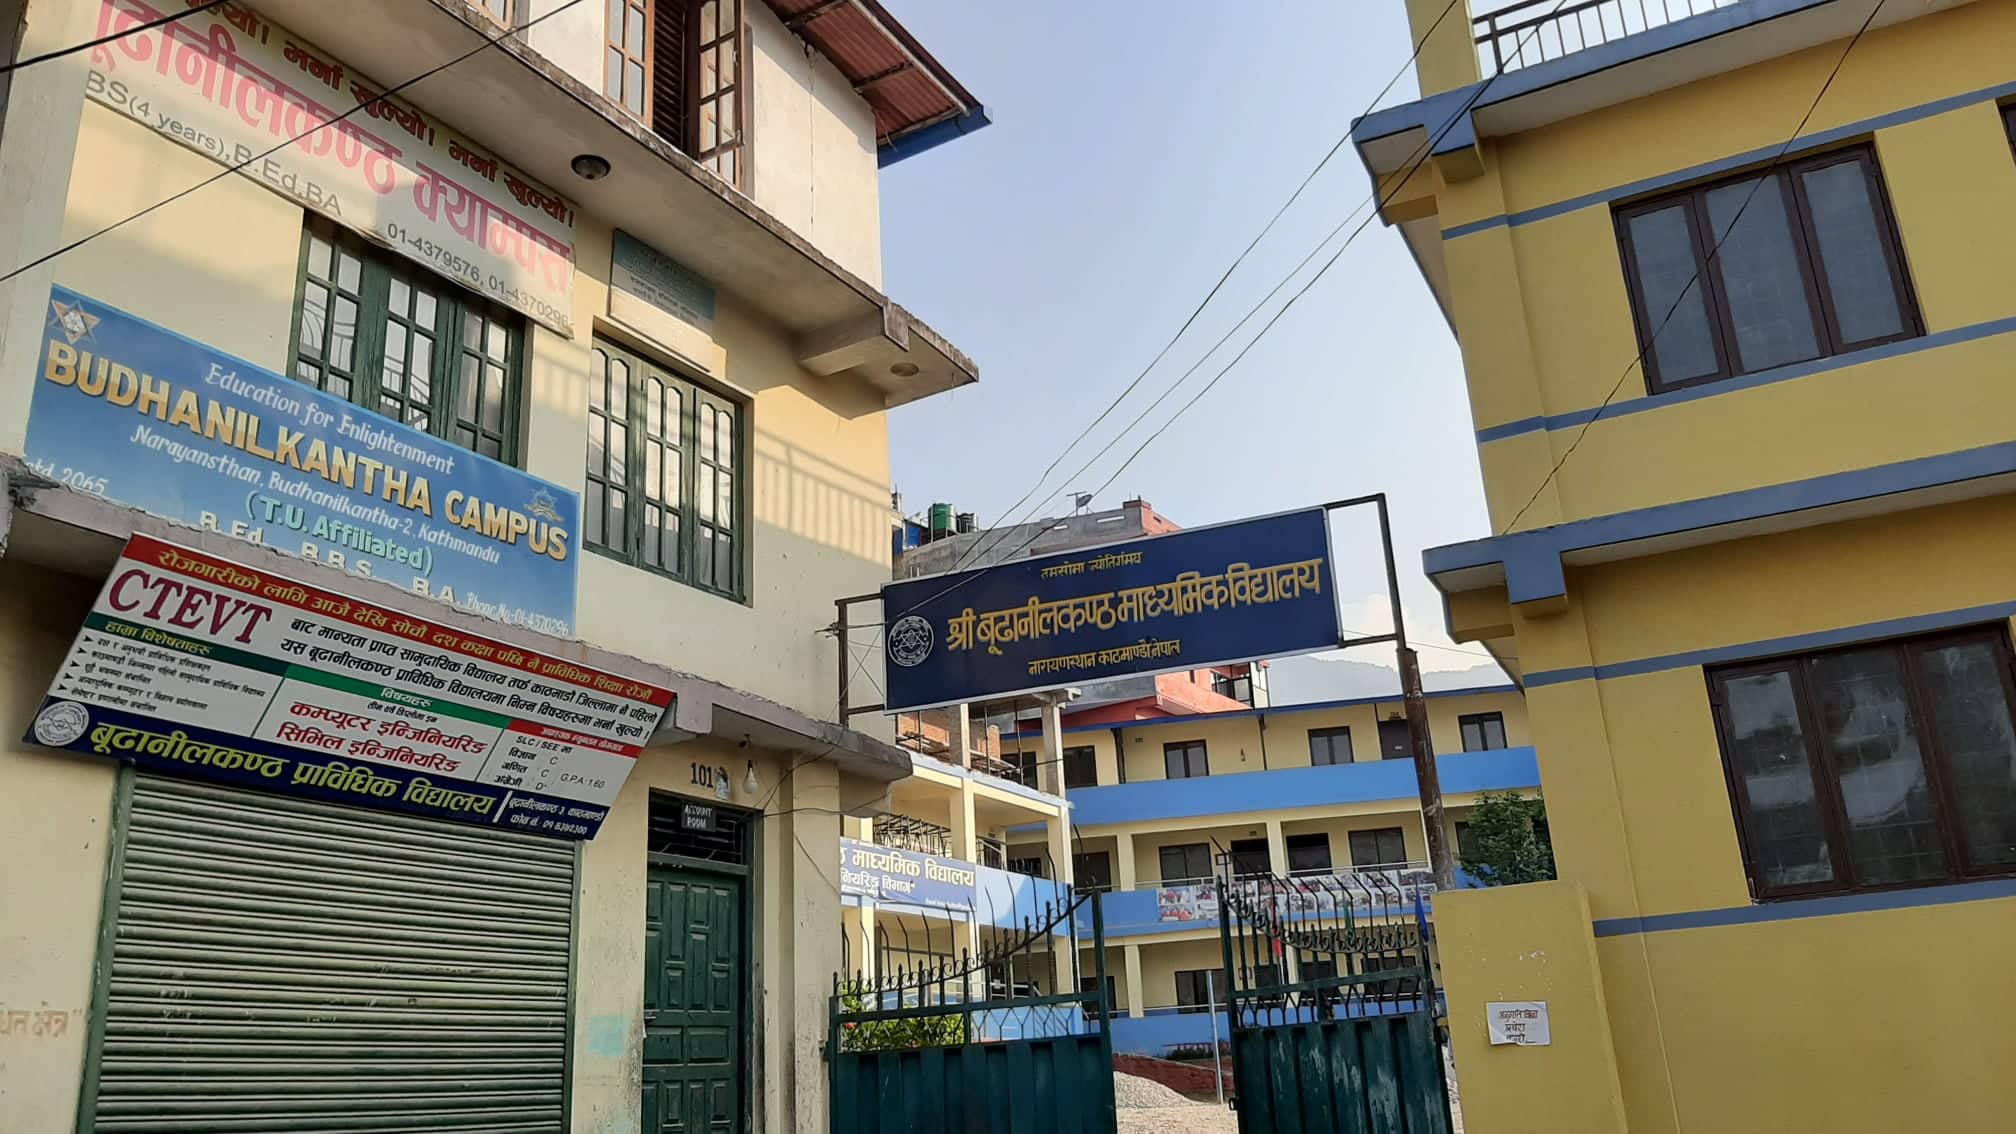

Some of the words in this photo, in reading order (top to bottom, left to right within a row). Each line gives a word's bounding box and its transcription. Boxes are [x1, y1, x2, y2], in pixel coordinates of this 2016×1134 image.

[204, 361, 300, 416] Education
[298, 398, 335, 429] for
[335, 416, 455, 475] Enlightenment
[44, 339, 432, 518] BUDHANILKANTHA
[443, 489, 570, 564] CAMPUS
[62, 468, 108, 495] 2065
[312, 513, 434, 578] Affiliated)
[418, 523, 501, 566] Kathmandu
[108, 568, 273, 645] CTEVT
[158, 549, 261, 591] रोजगारीको
[263, 581, 310, 605] लागि
[311, 597, 352, 616] आजै
[353, 606, 389, 628] देखि
[432, 631, 458, 649] दश
[460, 639, 495, 658] कक्षा
[496, 651, 524, 667] पछि
[527, 656, 541, 671] नै
[594, 674, 624, 693] शिक्षा
[946, 607, 977, 651] श्री
[976, 596, 1116, 655] बूढानीलकण्ठ
[1116, 571, 1228, 624] माध्यमिक
[1226, 562, 1324, 608] विद्यालय
[280, 638, 308, 656] यस
[394, 667, 448, 690] प्राविधिक
[448, 679, 506, 708] विद्यालयमा
[506, 694, 537, 712] निम्न
[592, 714, 616, 732] भर्ना
[291, 618, 318, 635] बाट
[318, 625, 368, 648] मान्यता
[368, 639, 399, 657] प्राप्त
[400, 647, 463, 674] सामुदायिक
[463, 658, 507, 685] विद्यालय
[508, 675, 531, 690] तर्फ
[575, 692, 618, 713] जिल्लामा
[618, 703, 630, 716] नै
[629, 706, 658, 724] पहिलो
[1028, 651, 1098, 676] नारायणस्थान
[276, 721, 347, 750] सिभिल
[348, 738, 462, 773] इन्जिनियरिङ
[378, 720, 489, 755] इन्जिनियरिङ
[516, 735, 535, 747] SLC
[540, 741, 559, 753] SEE
[549, 756, 559, 766] C
[90, 722, 290, 779] बूढानीलकण्ठ
[290, 761, 403, 799] प्राविधिक
[402, 777, 497, 815] विद्यालय
[540, 769, 549, 778] C
[684, 803, 713, 817] ACCOUNT
[687, 816, 707, 830] ROOM
[852, 848, 921, 877] माध्यमिक
[924, 858, 975, 887] विद्यालय
